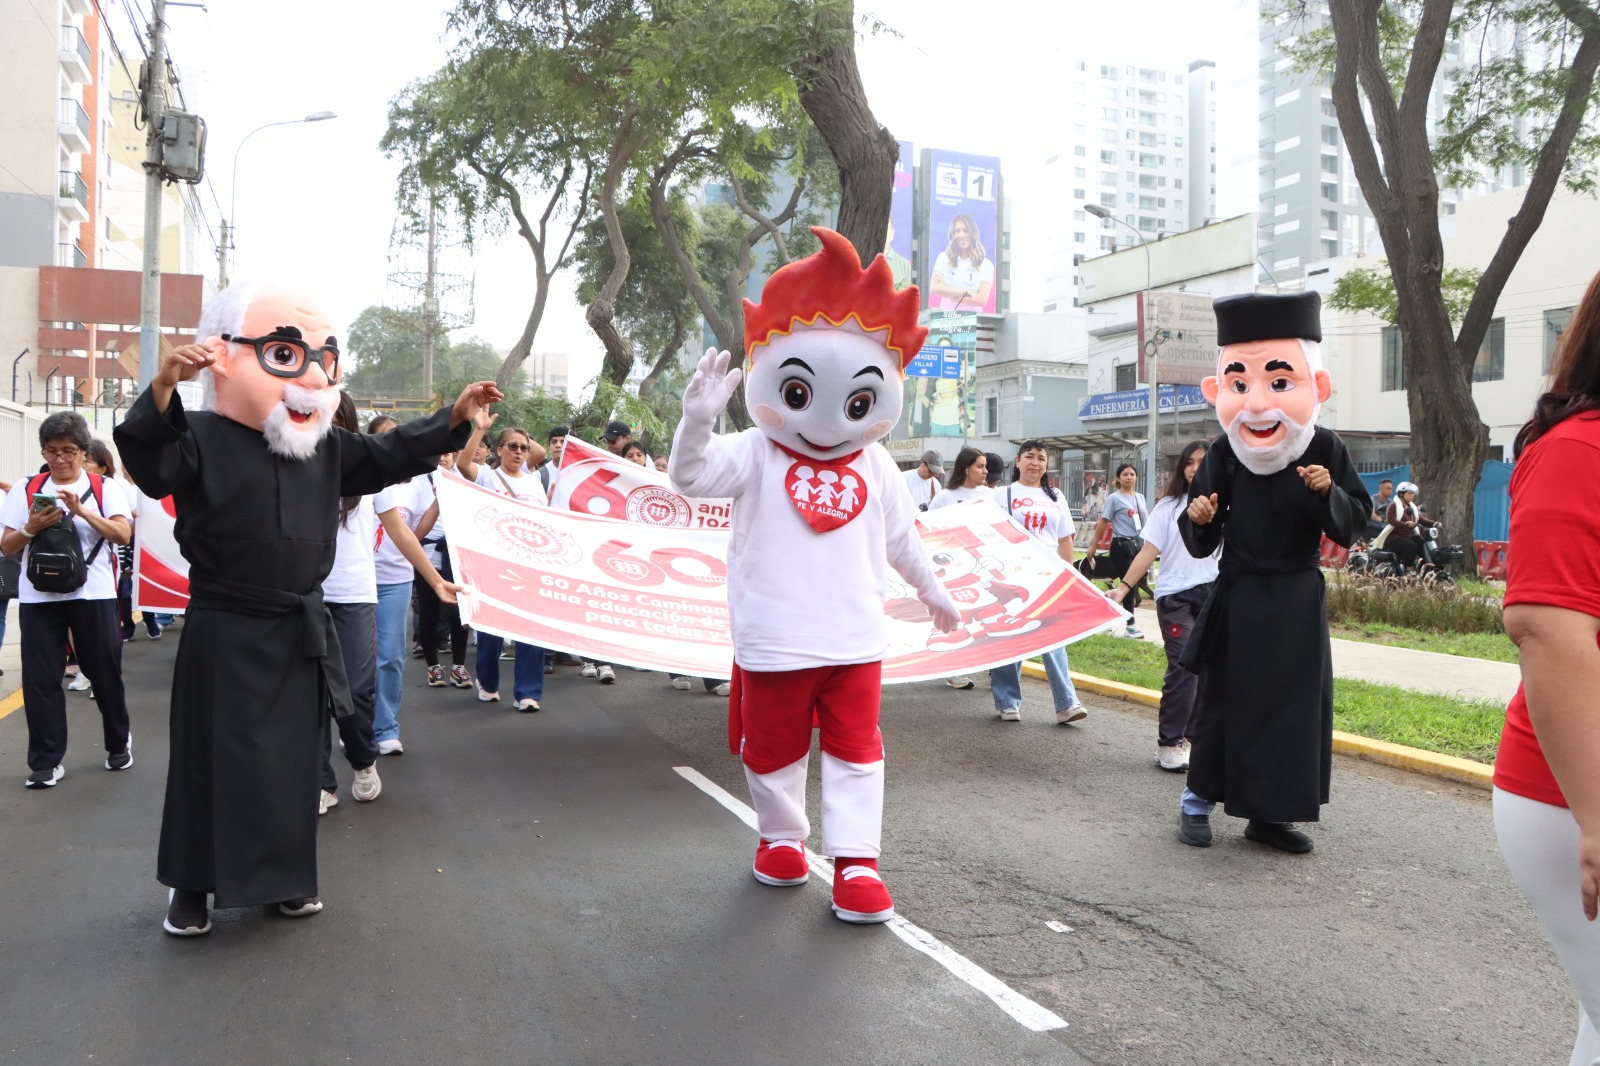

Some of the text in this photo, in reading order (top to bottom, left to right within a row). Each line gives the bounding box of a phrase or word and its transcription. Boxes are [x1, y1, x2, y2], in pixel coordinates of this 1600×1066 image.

[972, 174, 984, 197] 1
[1180, 313, 1213, 323] Educativa
[1090, 394, 1190, 415] ENFERMERÍA CNICA
[893, 440, 920, 450] MINEDU
[698, 503, 730, 518] ani
[797, 502, 807, 510] FE
[817, 506, 848, 520] ALEGRIA
[592, 539, 727, 588] 60
[694, 572, 727, 582] año
[540, 575, 729, 616] 60 Años Caminan
[539, 588, 726, 628] una educación de
[586, 611, 638, 629] para
[707, 631, 720, 642] y
